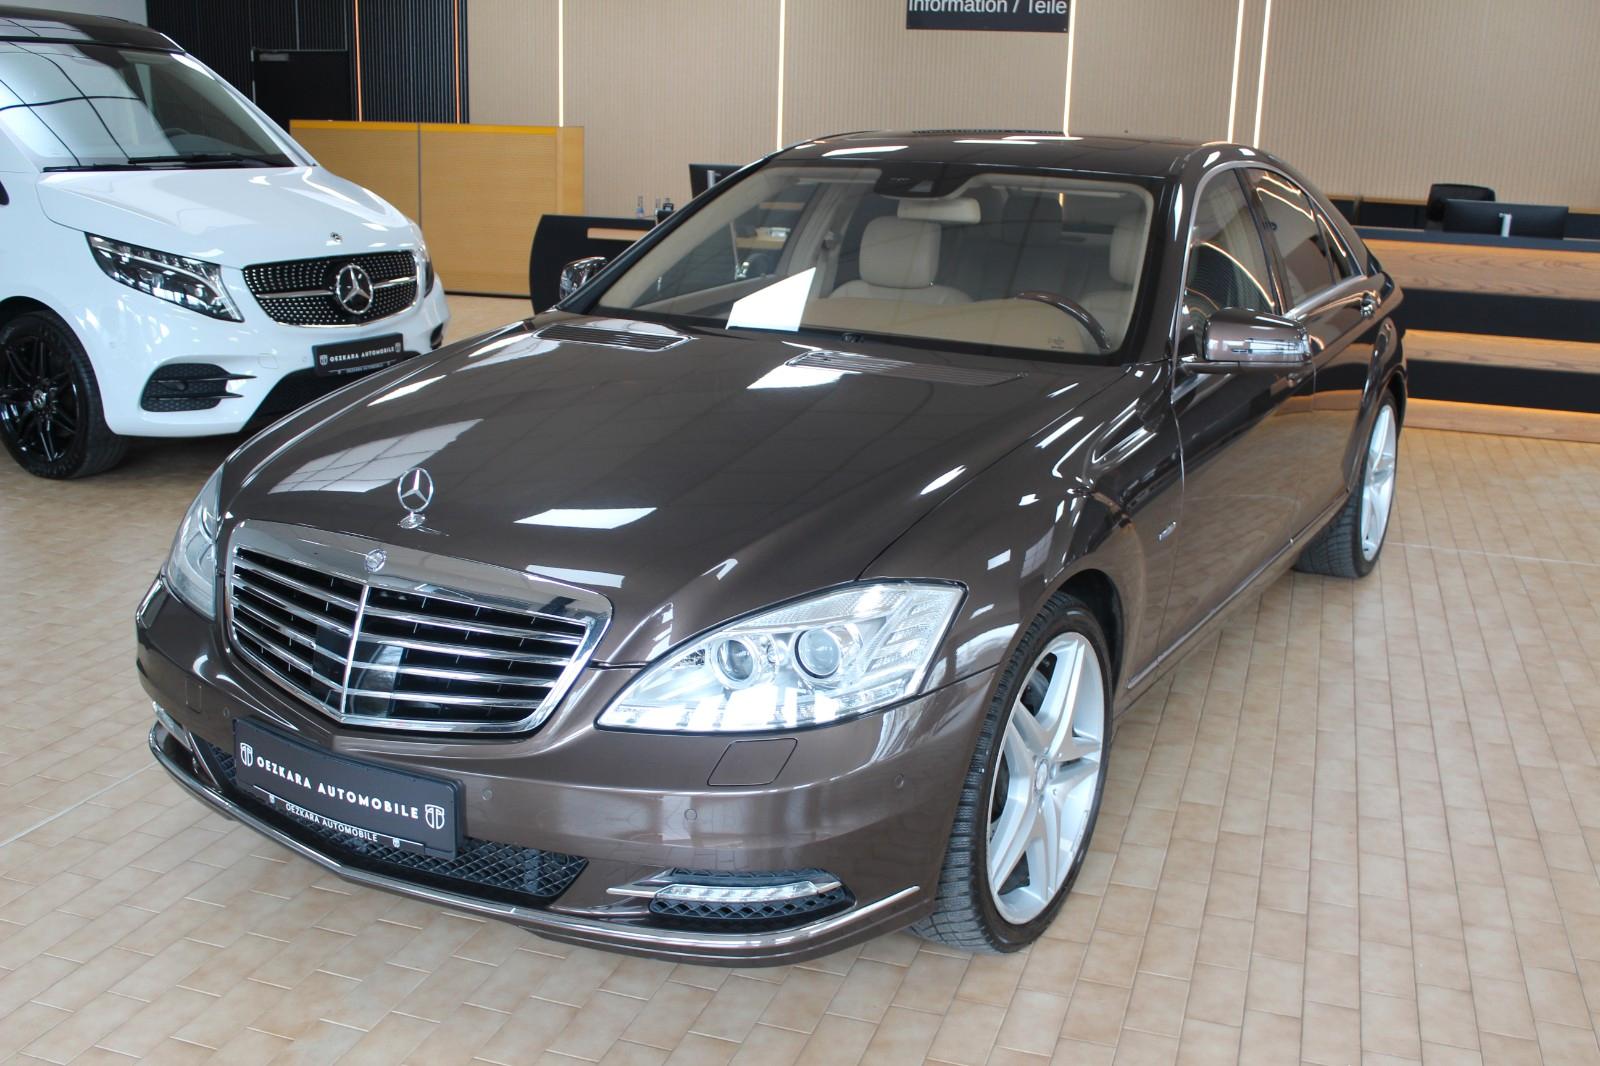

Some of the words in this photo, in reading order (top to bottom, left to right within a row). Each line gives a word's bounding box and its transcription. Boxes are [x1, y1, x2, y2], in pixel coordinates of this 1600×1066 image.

[908, 0, 1007, 13] Information
[1012, 0, 1020, 13] /
[329, 353, 359, 362] OEZKARA
[361, 346, 394, 357] AUTOMOBILE
[256, 756, 311, 789] OEZKARA
[318, 782, 419, 820] AUTOMOBILE
[285, 803, 320, 824] OEZKARA
[322, 818, 378, 842] AUTOMOBILE
